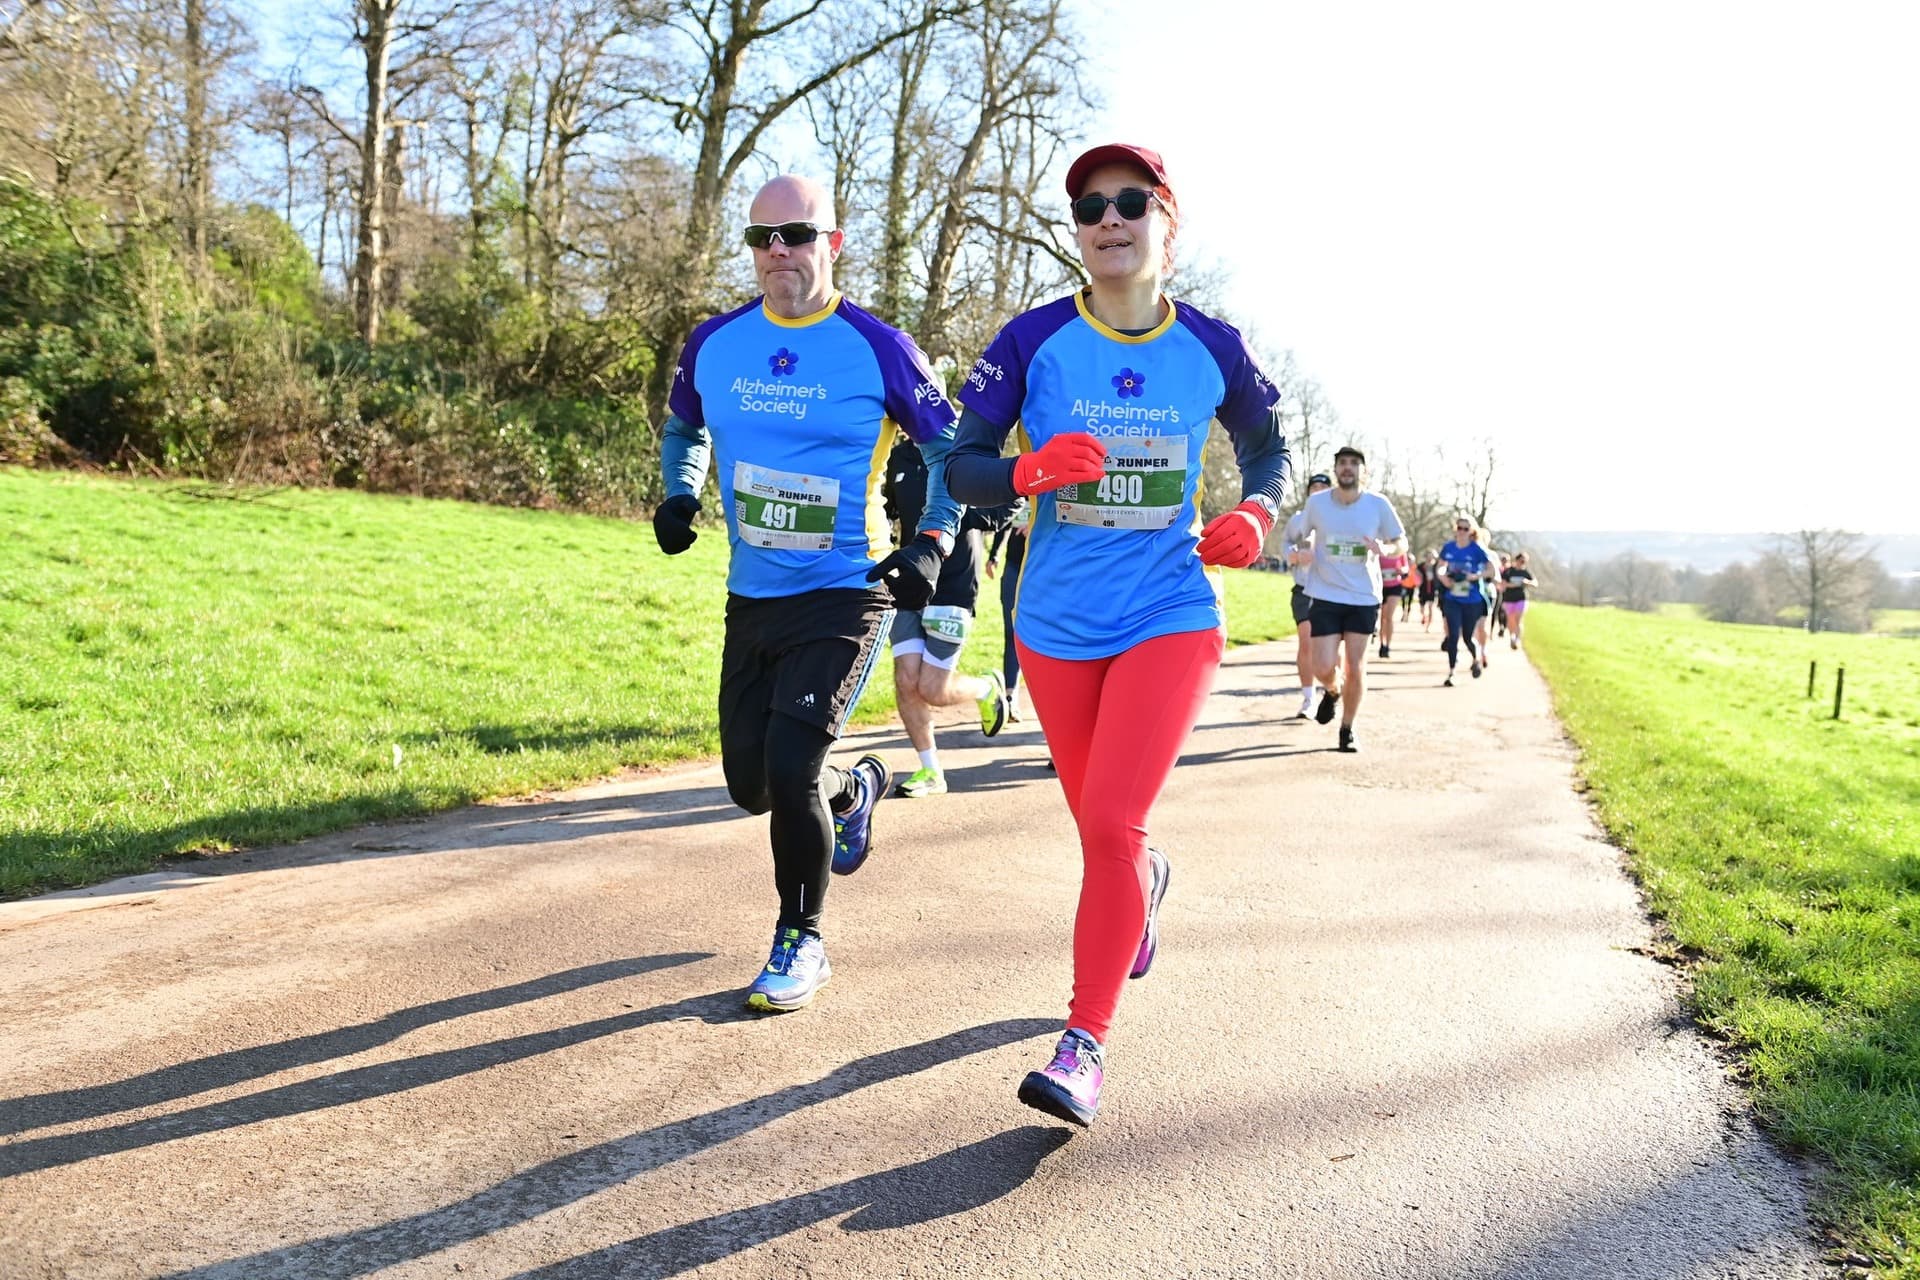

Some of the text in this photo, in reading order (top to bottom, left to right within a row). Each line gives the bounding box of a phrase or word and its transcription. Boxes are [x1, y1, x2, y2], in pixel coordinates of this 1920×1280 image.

[730, 377, 827, 399] Alzheimer's
[740, 395, 806, 420] Society
[1071, 399, 1180, 423] Alzheimer's
[1116, 457, 1169, 467] RUNNER
[777, 490, 822, 503] RUNNER
[1096, 474, 1143, 504] 490
[760, 502, 797, 530] 491
[939, 620, 959, 636] 322
